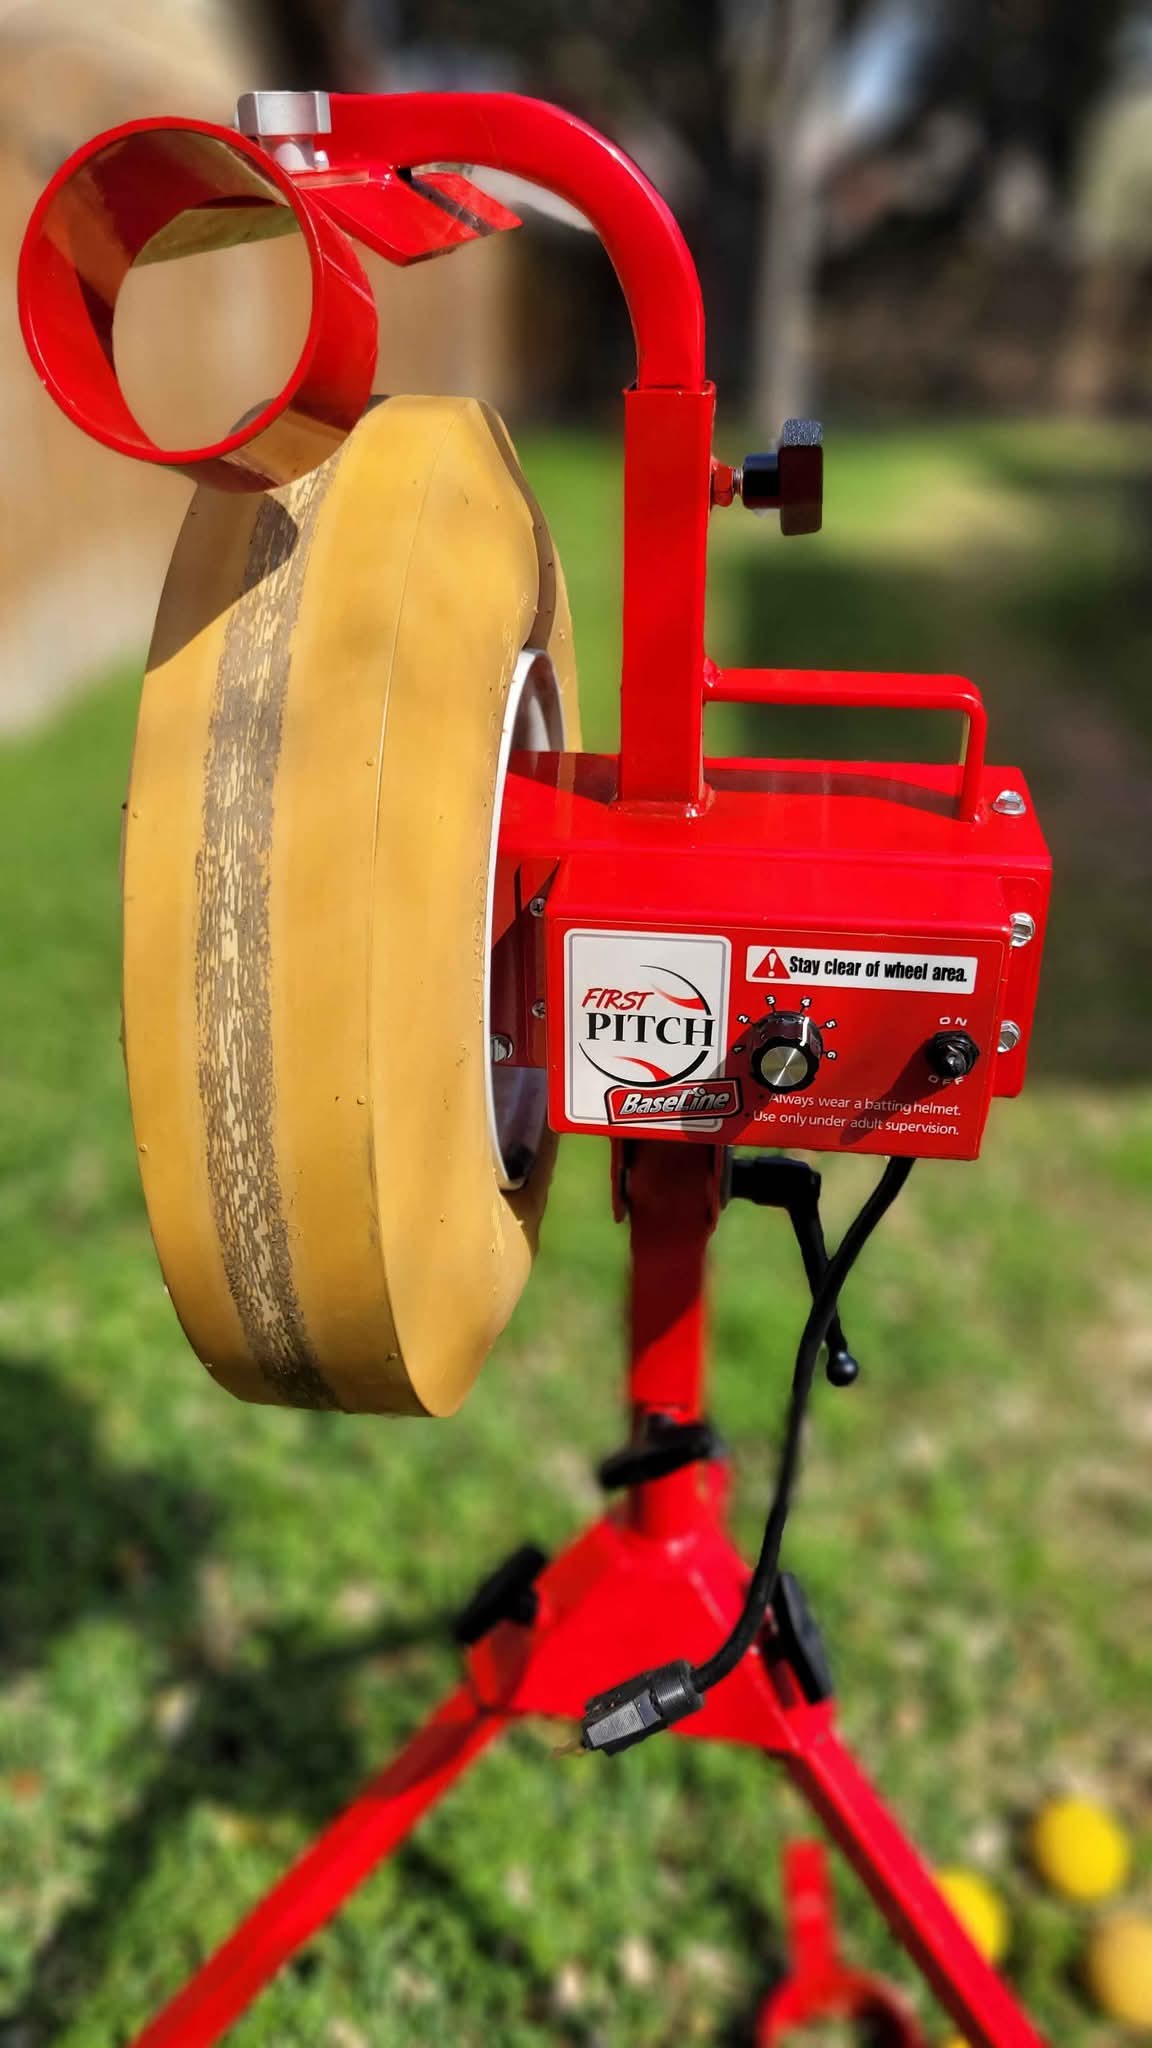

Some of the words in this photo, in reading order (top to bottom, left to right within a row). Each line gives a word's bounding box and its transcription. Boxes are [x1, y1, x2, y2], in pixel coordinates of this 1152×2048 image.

[789, 955, 820, 976] Stay
[824, 958, 862, 977] clear
[865, 960, 881, 977] of
[884, 961, 928, 981] wheel
[932, 965, 968, 982] area.
[581, 987, 654, 1011] FIRST
[766, 995, 776, 1005] 3
[586, 1012, 716, 1047] PITCH
[738, 1014, 749, 1024] 2
[826, 1019, 836, 1029] 5
[939, 1015, 968, 1027] ON
[928, 1074, 964, 1087] OFF
[619, 1086, 730, 1115] BaseLine
[769, 1093, 814, 1108] Always
[818, 1097, 850, 1108] wear
[854, 1099, 862, 1109] a
[864, 1098, 912, 1115] batting
[913, 1101, 961, 1116] helmet.
[753, 1110, 777, 1122] Use
[779, 1112, 808, 1127] only
[808, 1115, 848, 1127] under
[849, 1117, 883, 1130] adult
[885, 1120, 960, 1136] supervision.
